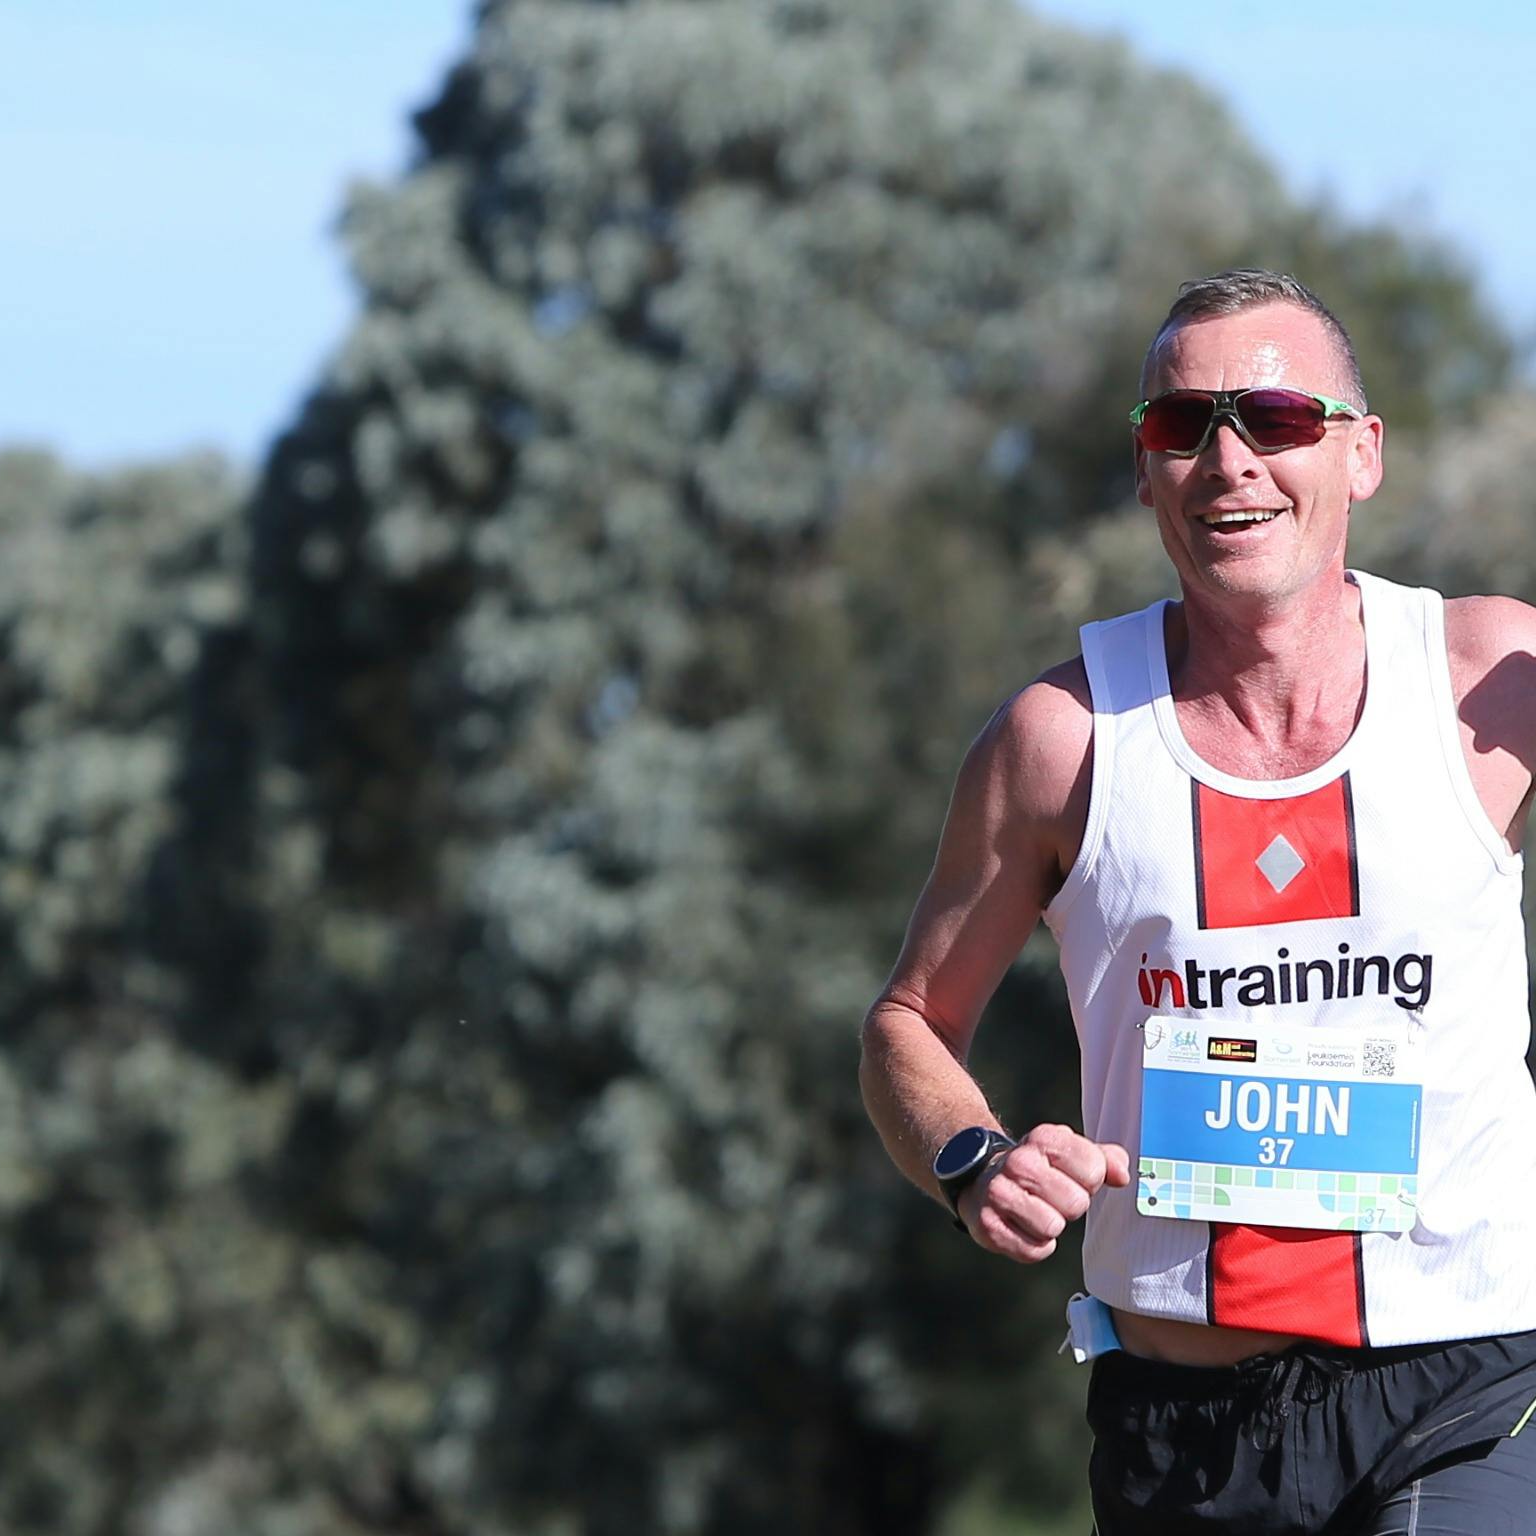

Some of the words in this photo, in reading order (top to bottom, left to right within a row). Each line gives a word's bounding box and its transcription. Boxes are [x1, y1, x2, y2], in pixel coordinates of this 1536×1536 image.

[1137, 942, 1433, 1011] intraining
[1209, 1041, 1232, 1056] A&M
[1307, 1060, 1356, 1069] Foundation
[1204, 1080, 1351, 1136] JOHN
[1258, 1137, 1295, 1166] 37
[1364, 1207, 1386, 1225] 37
